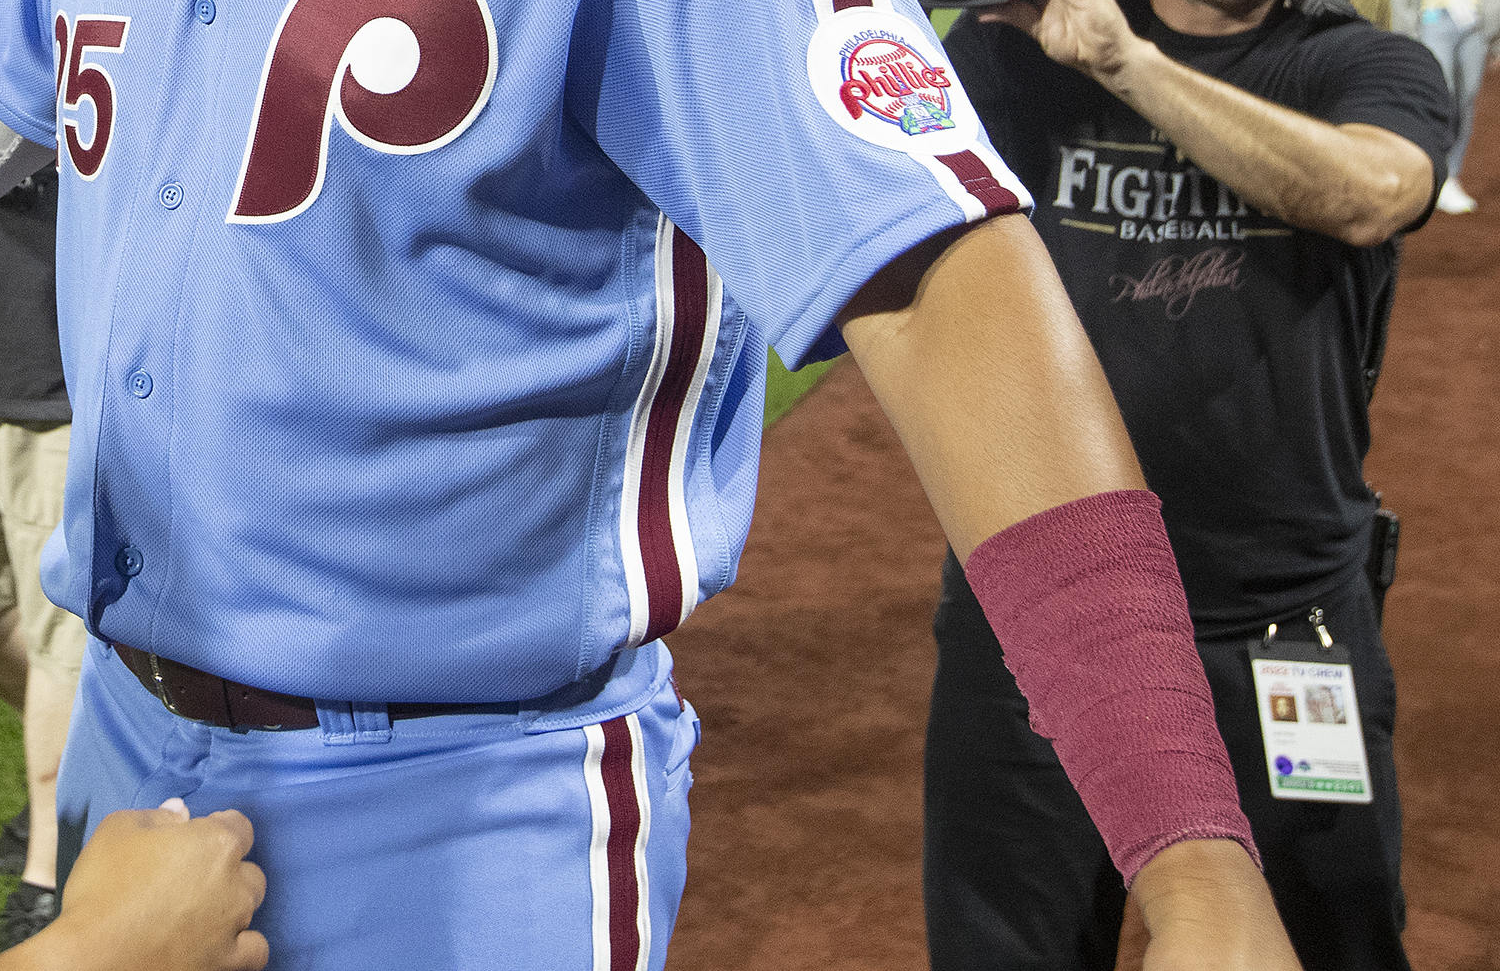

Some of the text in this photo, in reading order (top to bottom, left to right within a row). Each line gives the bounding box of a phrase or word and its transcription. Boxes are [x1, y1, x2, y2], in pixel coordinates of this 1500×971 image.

[838, 29, 909, 60] PHILADELPHIA
[1052, 146, 1249, 221] FIGHTI
[1119, 219, 1248, 244] BASEBALL
